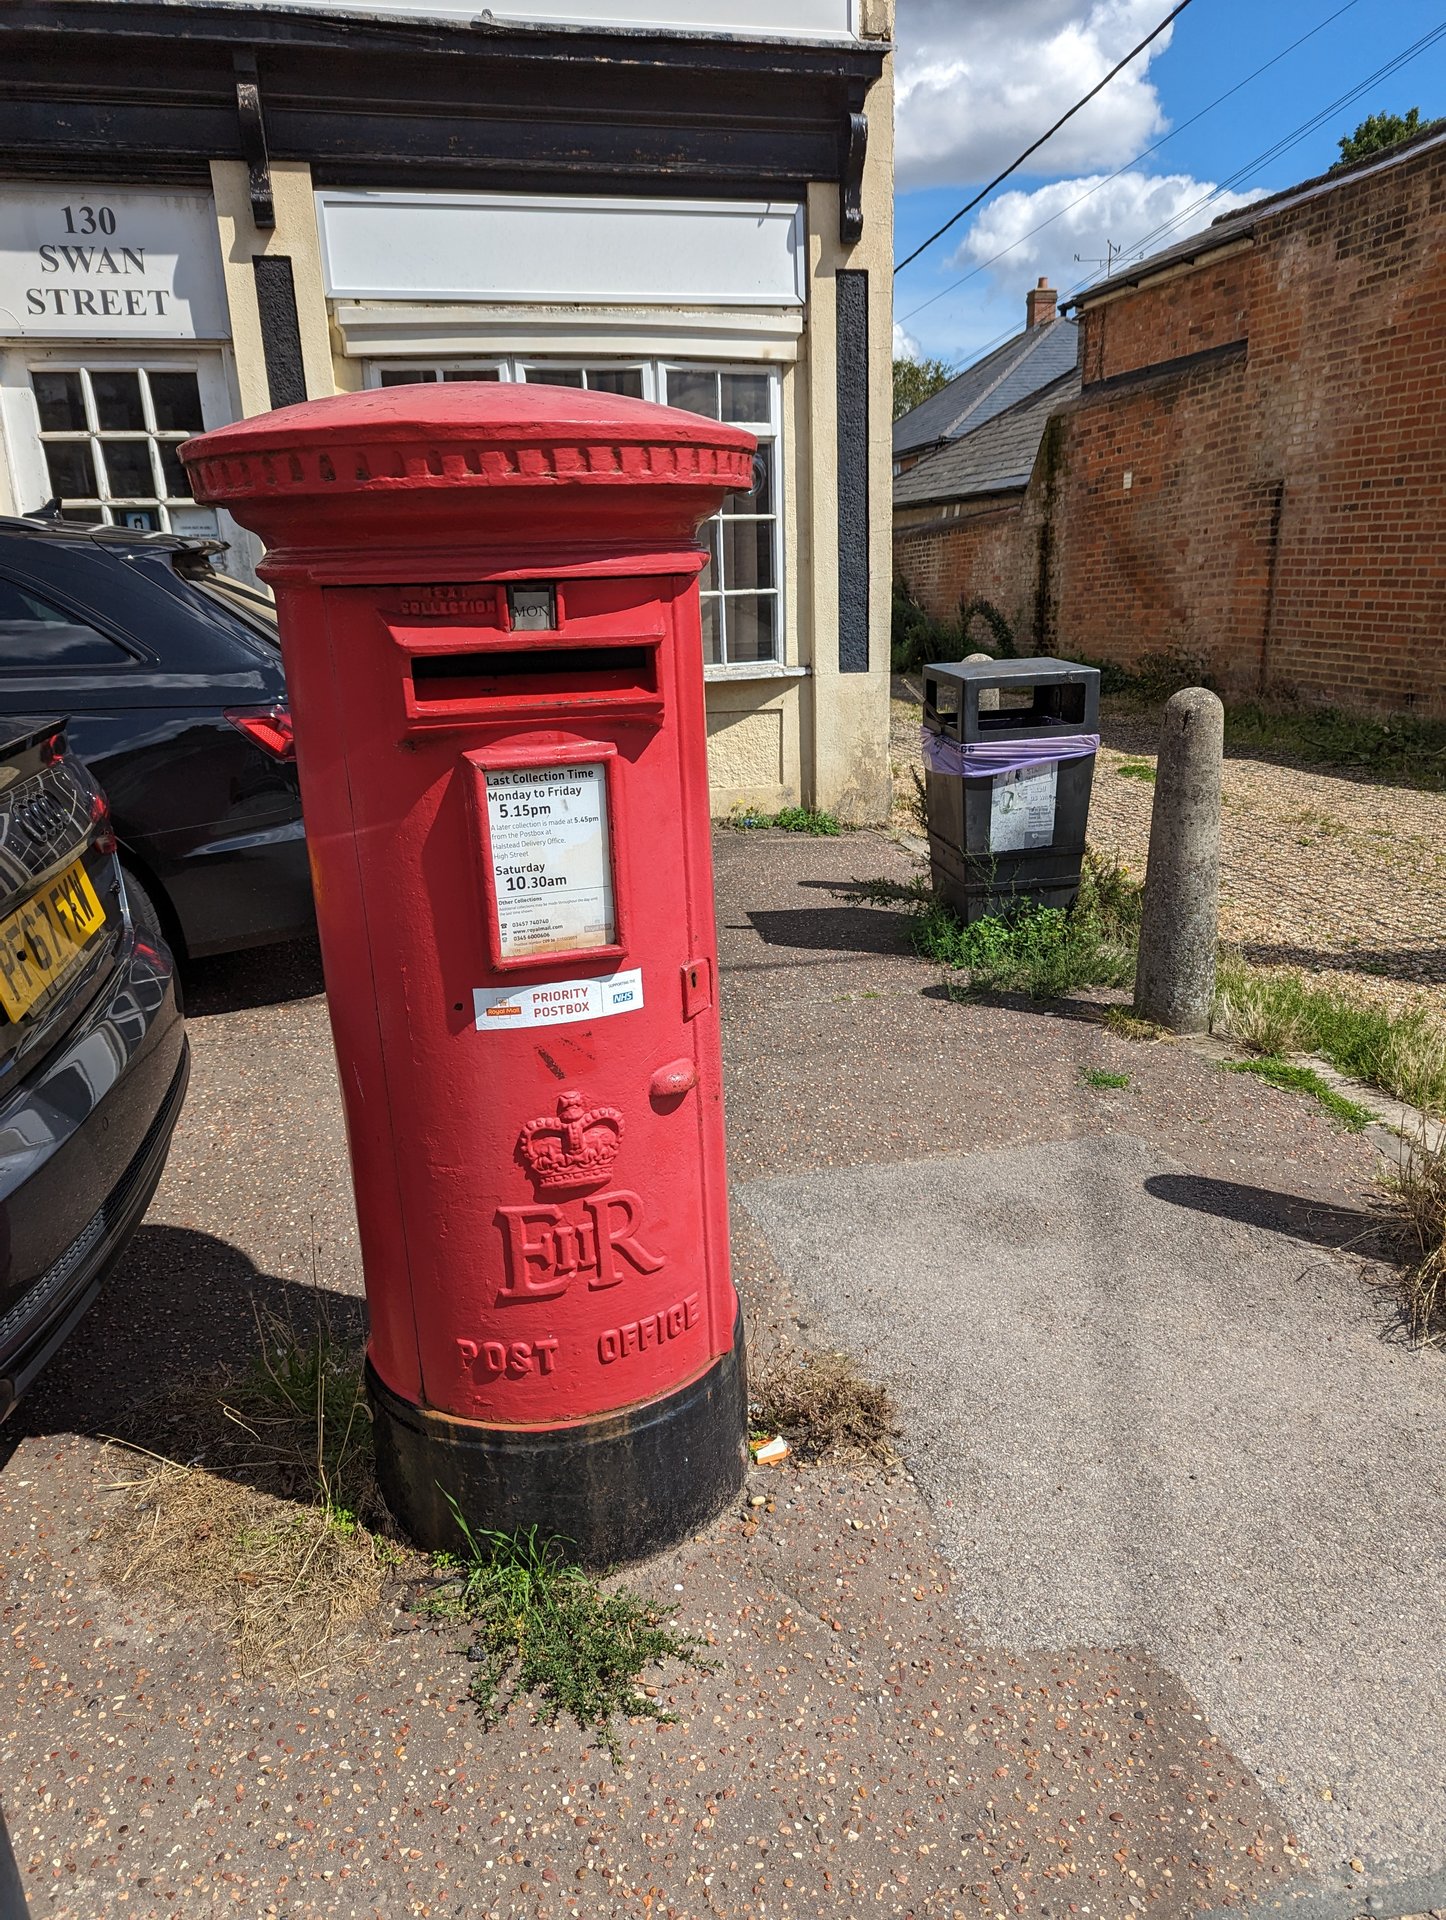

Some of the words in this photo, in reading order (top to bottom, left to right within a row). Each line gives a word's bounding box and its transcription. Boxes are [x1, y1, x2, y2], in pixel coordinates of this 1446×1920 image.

[61, 205, 116, 236] 130
[39, 244, 146, 275] SWAN
[26, 288, 170, 316] STREET
[402, 600, 496, 615] COLLECTION
[514, 605, 550, 618] MON
[486, 776, 510, 786] Last
[513, 771, 565, 784] Collection
[567, 769, 594, 779] Time
[488, 790, 531, 802] Monday
[534, 789, 545, 798] to
[548, 786, 582, 797] Friday
[500, 804, 551, 819] 5.15pm
[512, 821, 541, 830] collection
[574, 816, 599, 824] 5.45pm
[519, 830, 544, 838] Postbox
[493, 841, 520, 850] Halstead
[521, 839, 546, 849] Delivery
[494, 853, 509, 861] High
[495, 862, 545, 876] Saturday
[506, 875, 567, 891] 10.30am
[513, 924, 564, 934] www.royalmail.com
[532, 987, 589, 1004] PRIORITY
[613, 991, 633, 1003] NHS
[487, 1007, 505, 1016] Royal
[507, 1007, 521, 1015] Mail
[534, 1002, 590, 1018] POSTBOX
[456, 1337, 558, 1372] POST
[599, 1292, 700, 1364] OFFICE
